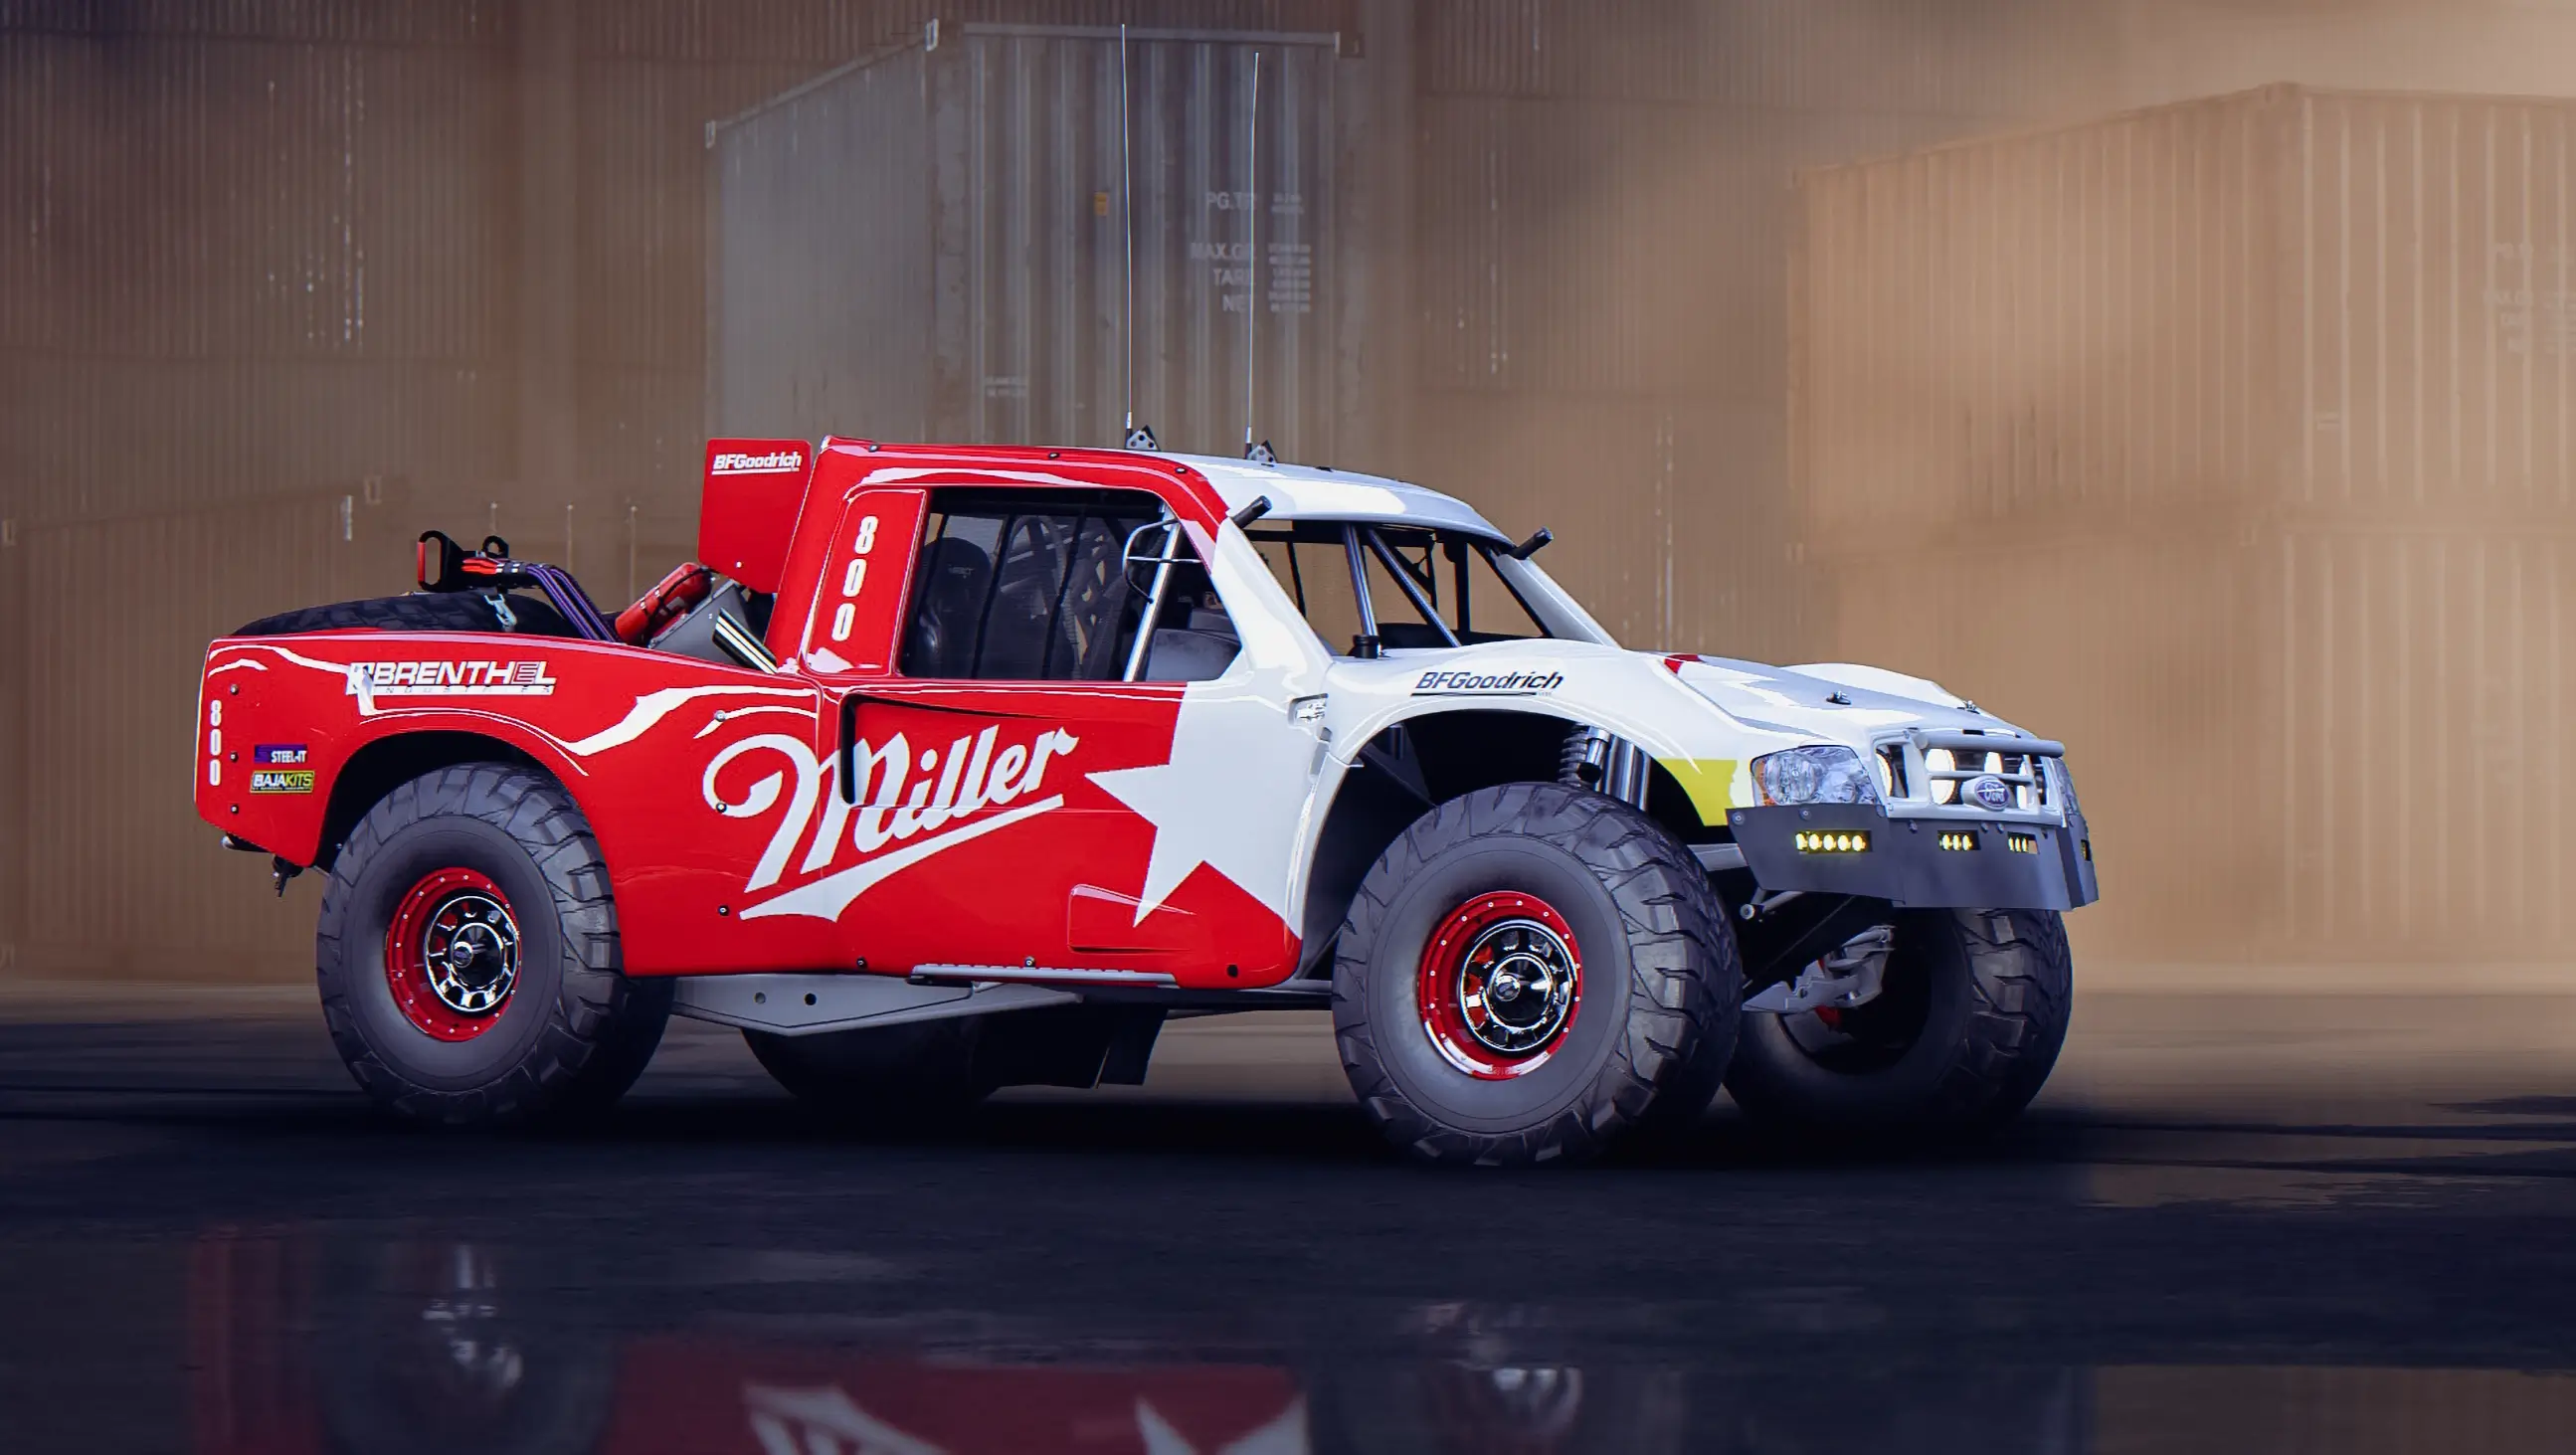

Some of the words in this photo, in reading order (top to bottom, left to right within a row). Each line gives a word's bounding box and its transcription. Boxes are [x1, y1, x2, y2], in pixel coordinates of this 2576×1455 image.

[1222, 293, 1255, 312] NE
[713, 452, 802, 470] BFGoodrich
[831, 515, 879, 641] 800
[372, 660, 557, 685] BRENTHEL
[1415, 670, 1564, 689] BFGoodrich
[209, 699, 222, 787] 800
[271, 750, 307, 764] STEEL-IT
[702, 724, 1079, 894] Miller
